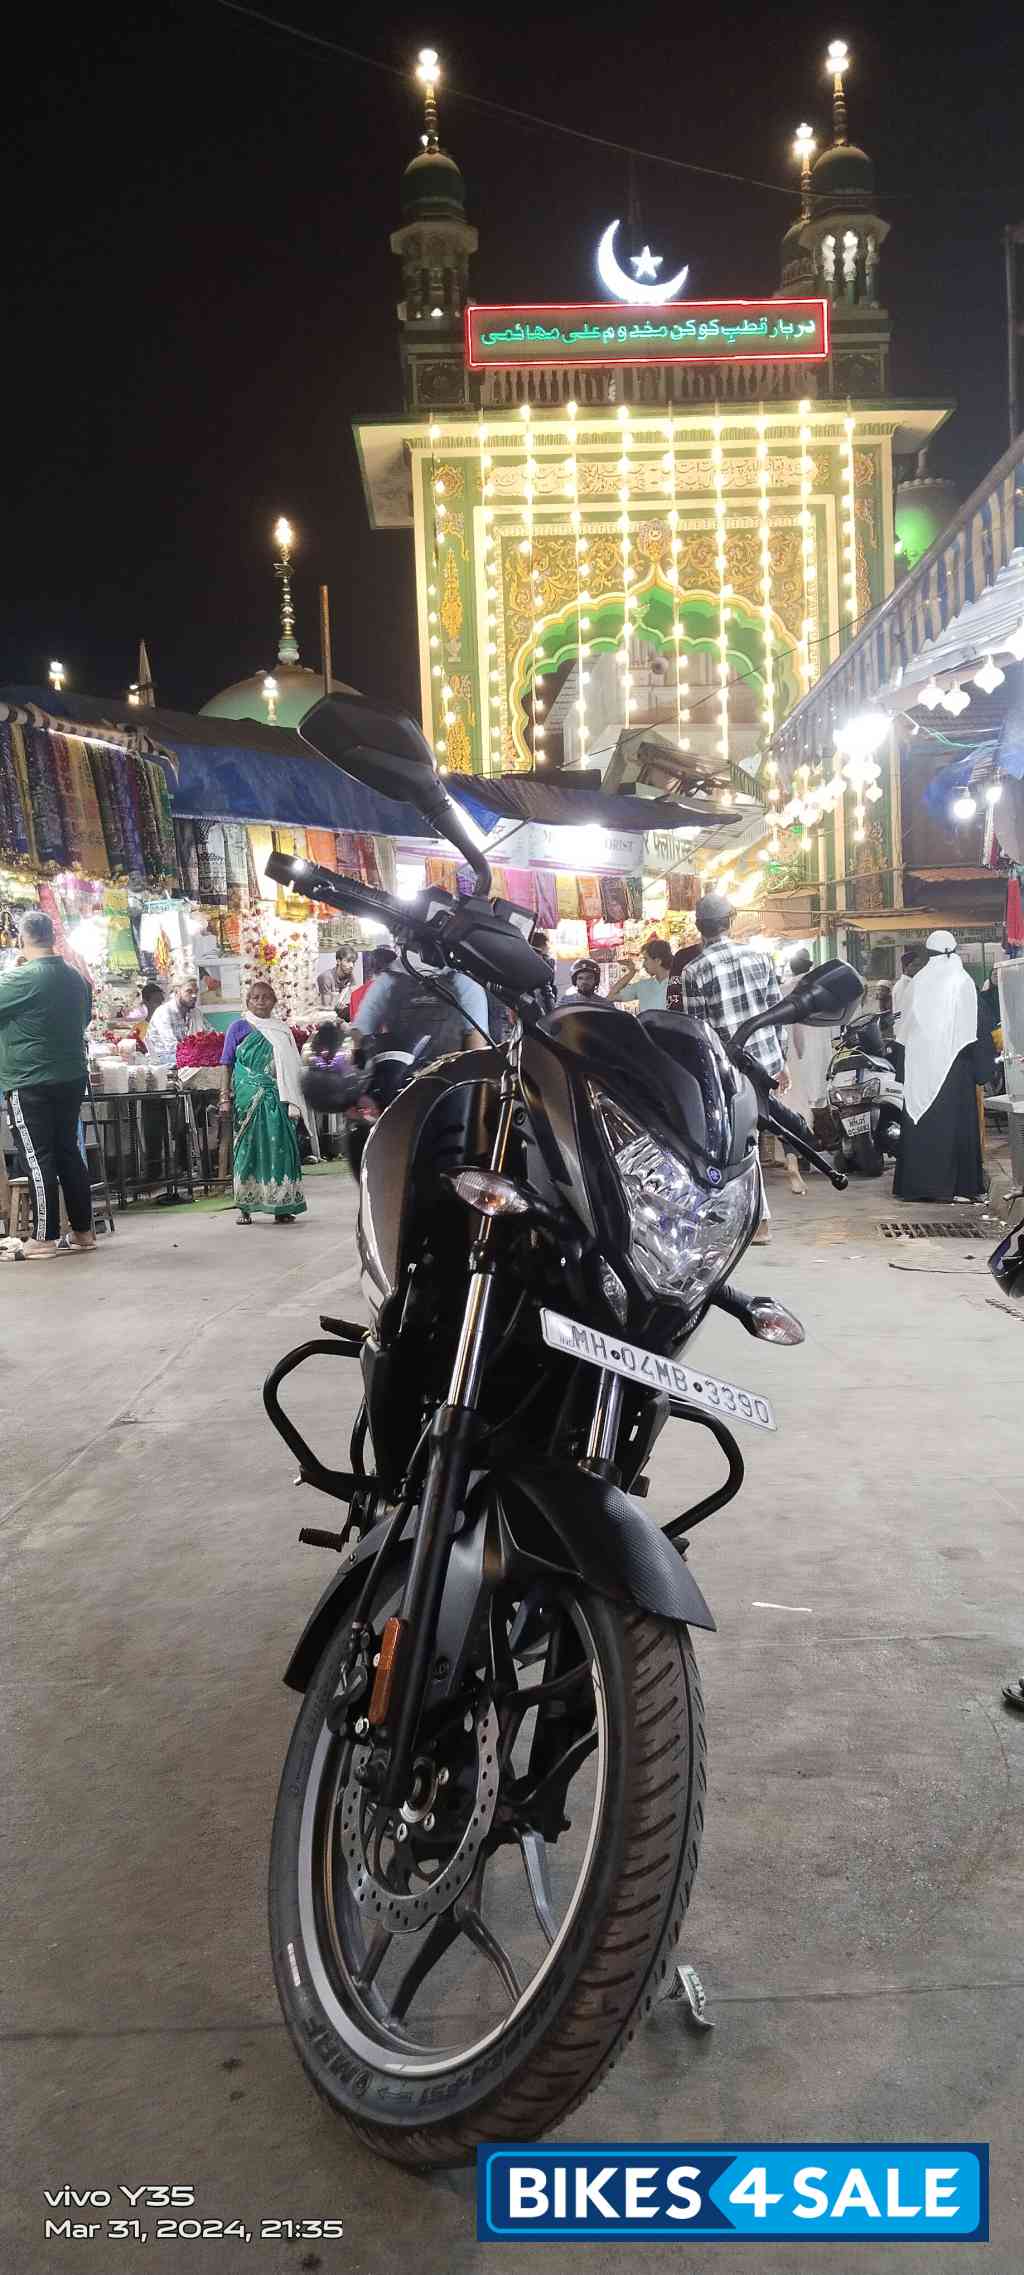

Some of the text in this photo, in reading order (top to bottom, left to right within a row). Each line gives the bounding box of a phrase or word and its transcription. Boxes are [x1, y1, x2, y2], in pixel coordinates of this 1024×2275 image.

[769, 319, 816, 341] دربار
[572, 1325, 608, 1360] MH
[703, 1376, 770, 1424] 3390
